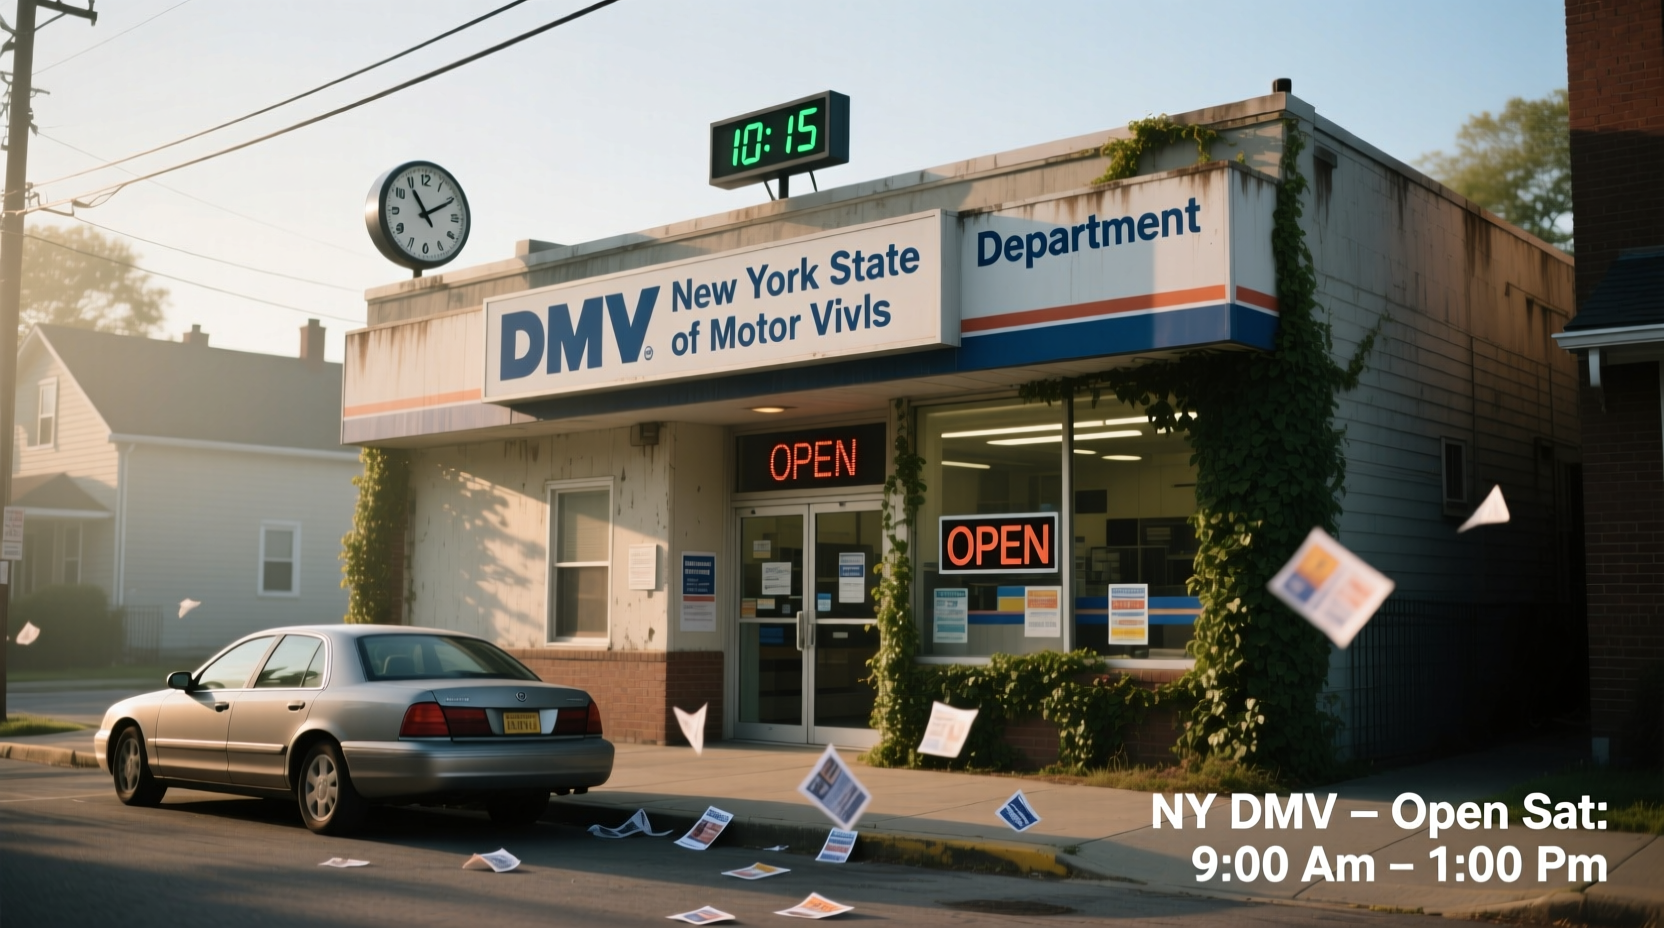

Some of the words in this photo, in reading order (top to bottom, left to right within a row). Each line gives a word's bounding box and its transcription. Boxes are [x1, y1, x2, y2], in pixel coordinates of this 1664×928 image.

[732, 107, 818, 167] 10:15
[421, 173, 432, 187] 12
[977, 197, 1201, 269] Department
[671, 277, 738, 312] New
[746, 256, 820, 299] York
[829, 243, 921, 286] State
[500, 285, 660, 381] DMV
[671, 320, 702, 357] of
[710, 312, 803, 351] Motor
[809, 293, 892, 336] Vivls
[769, 438, 857, 482] OPEN
[946, 523, 1050, 567] OPEN
